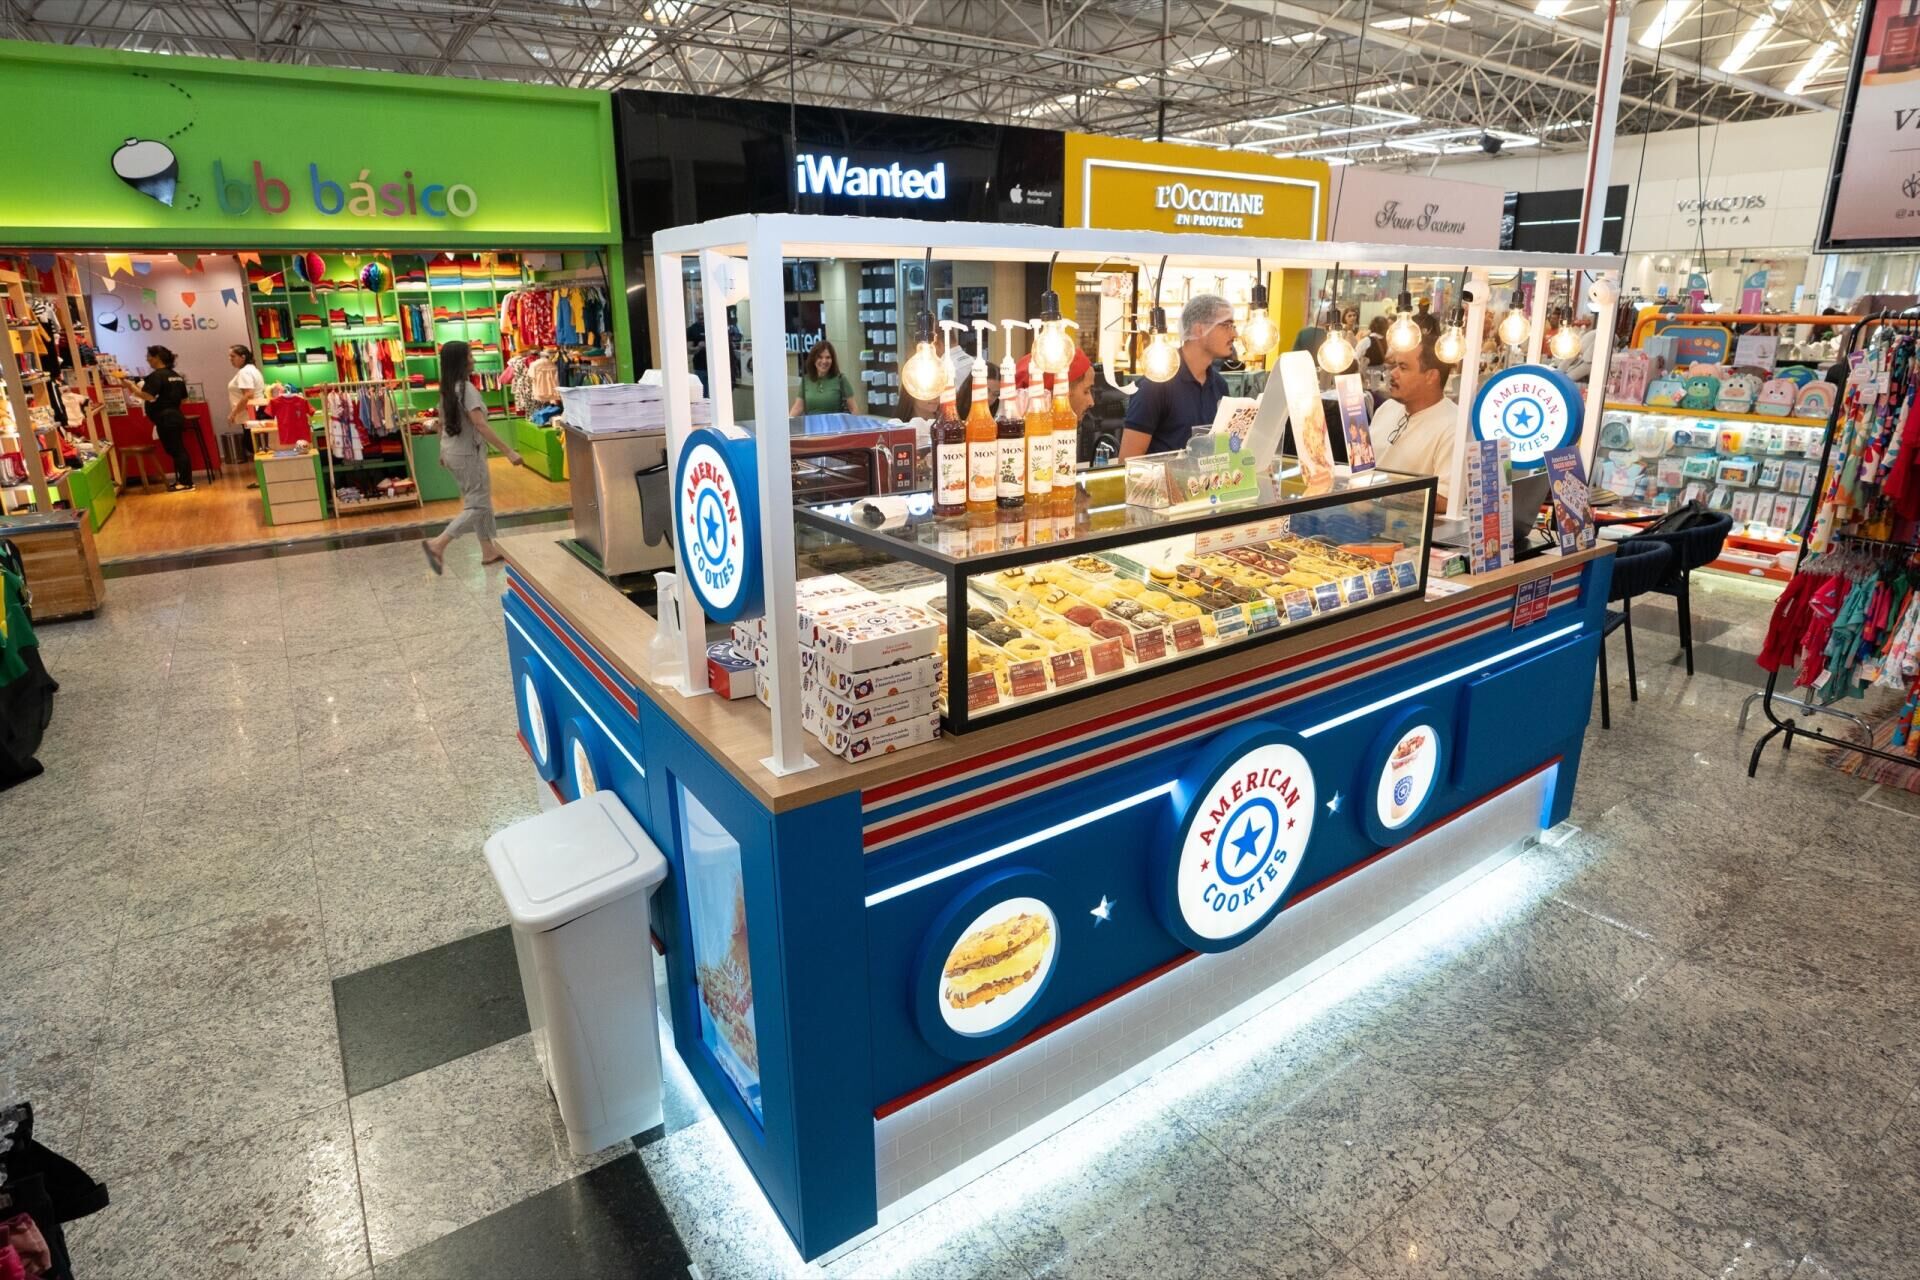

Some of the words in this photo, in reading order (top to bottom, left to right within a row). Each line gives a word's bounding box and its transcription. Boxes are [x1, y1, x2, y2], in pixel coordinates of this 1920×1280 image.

[213, 157, 291, 216] bb
[309, 162, 478, 219] básico
[796, 153, 946, 200] iWanted
[1156, 183, 1264, 215] L'OCCITANE
[1375, 200, 1416, 230] Four
[1416, 203, 1466, 234] Seasons
[1174, 214, 1191, 226] EN
[1192, 215, 1244, 229] PROVENCE
[127, 313, 153, 331] bb
[159, 313, 219, 331] básico
[785, 328, 823, 353] anted
[1493, 383, 1560, 415] AMERICAN
[687, 461, 737, 523] AMERICAN
[692, 541, 735, 590] COOKIES
[1199, 767, 1300, 846] AMERICAN
[1203, 848, 1288, 912] COOKIES
